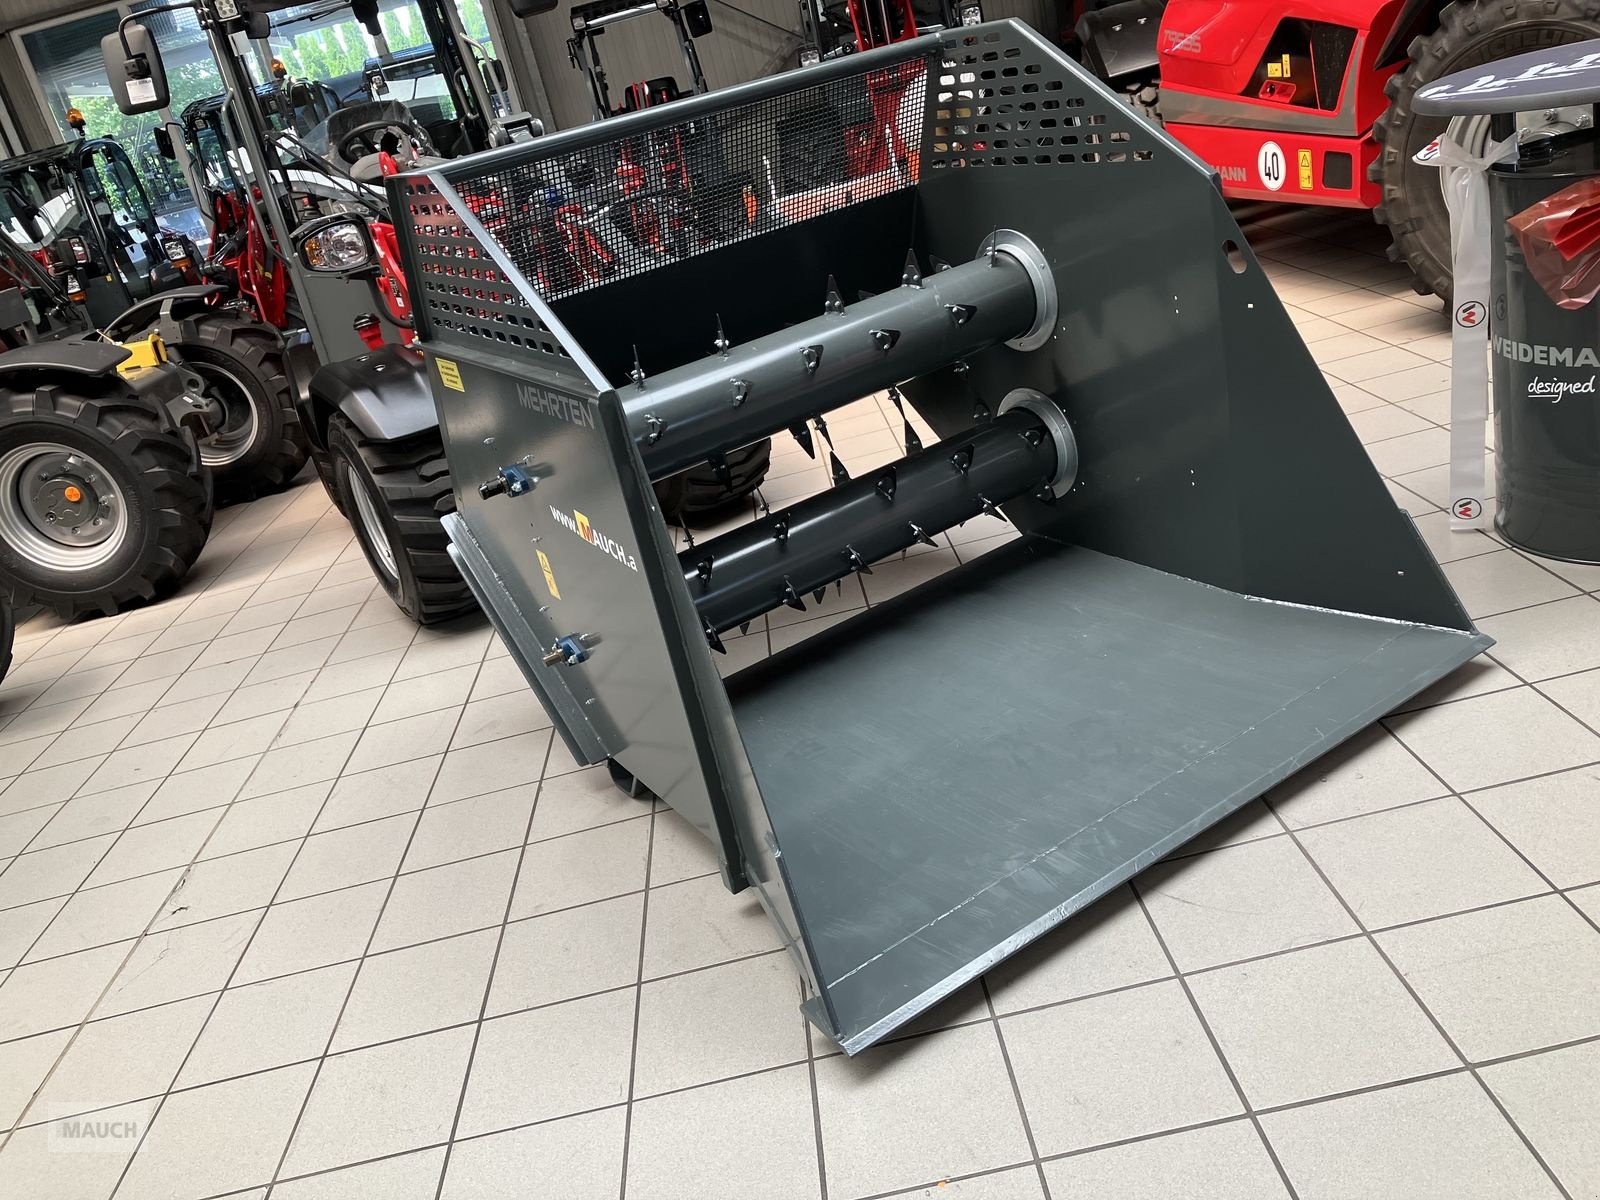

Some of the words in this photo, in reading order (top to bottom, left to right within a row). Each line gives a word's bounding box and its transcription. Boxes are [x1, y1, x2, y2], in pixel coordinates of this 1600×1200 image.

[1264, 151, 1280, 181] 40
[1527, 375, 1596, 404] designed
[515, 382, 594, 430] MEHRTEN
